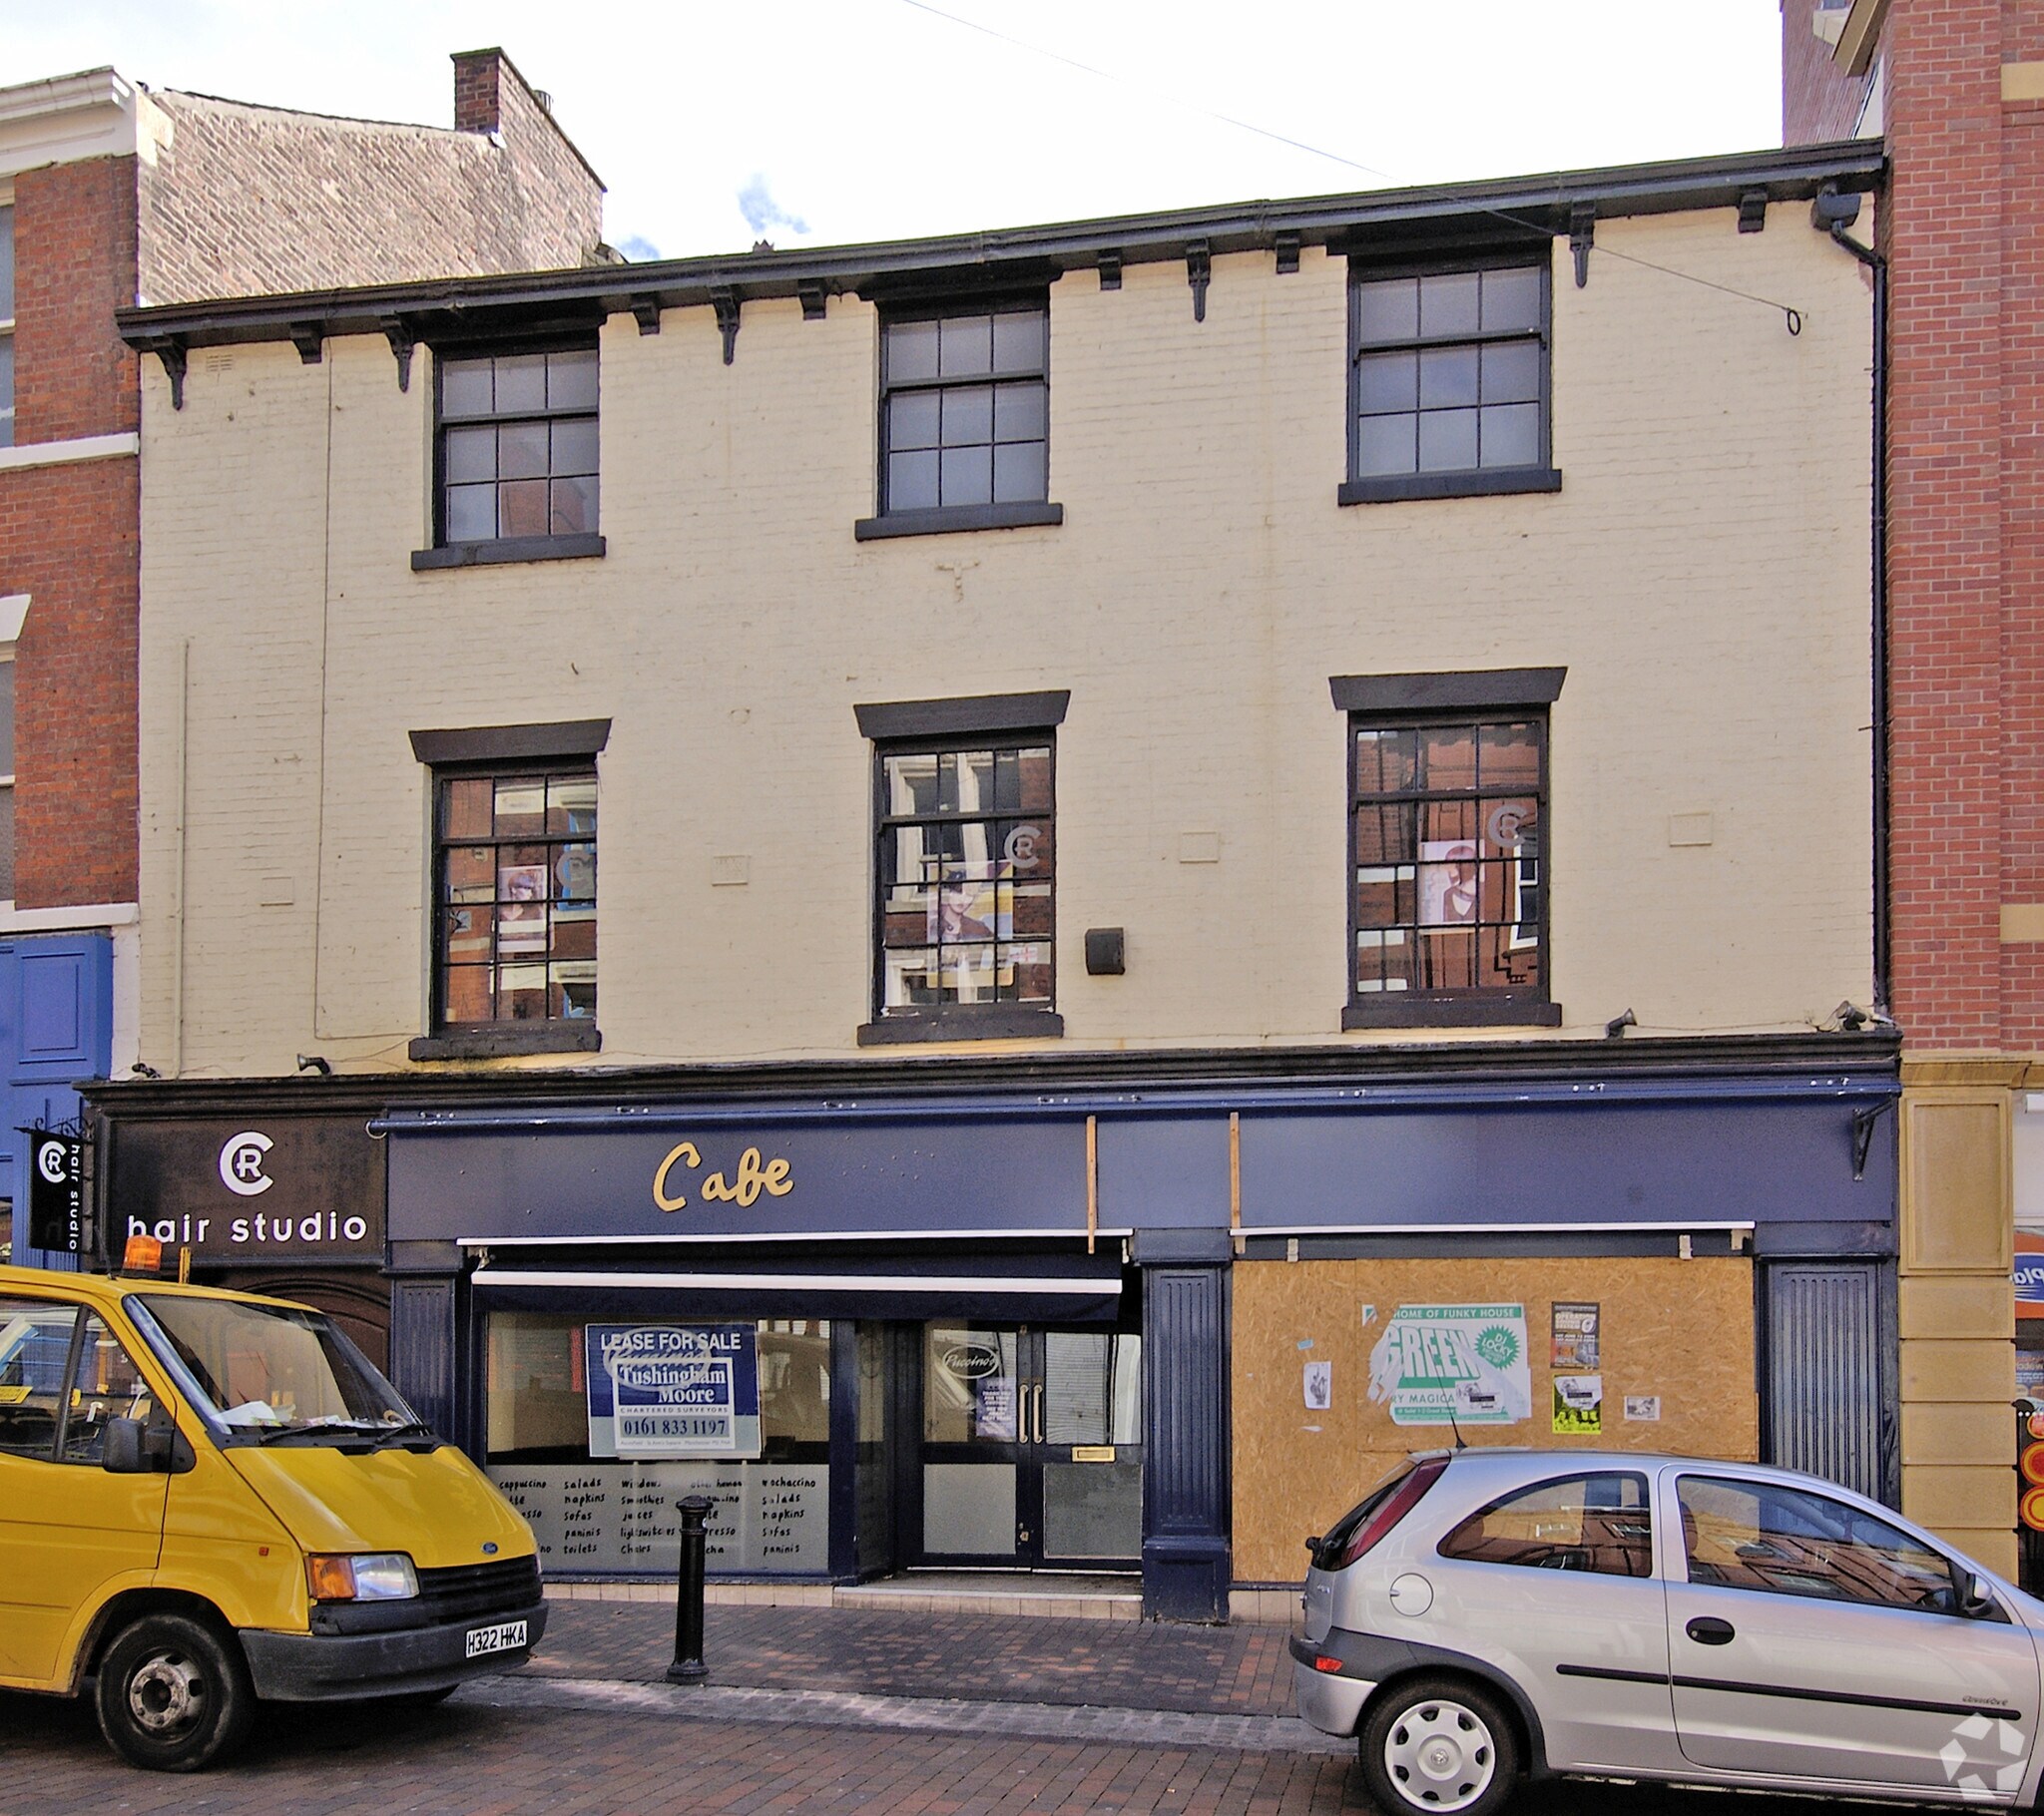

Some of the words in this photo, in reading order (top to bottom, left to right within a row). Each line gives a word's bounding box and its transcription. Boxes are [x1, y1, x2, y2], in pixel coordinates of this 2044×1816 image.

[70, 1143, 81, 1182] hair
[653, 1140, 794, 1212] Cafe
[69, 1190, 80, 1250] studio
[128, 1213, 210, 1244] hair
[230, 1211, 367, 1242] studio
[1393, 1308, 1422, 1319] HOME
[1426, 1308, 1440, 1318] OF
[1443, 1308, 1477, 1318] FUNKY
[1480, 1307, 1514, 1318] HOUSE
[601, 1333, 655, 1350] LEASE
[660, 1333, 693, 1350] FOR
[698, 1333, 743, 1350] SALE
[620, 1365, 726, 1387] Tushingham
[658, 1388, 715, 1404] Moore
[624, 1418, 656, 1436] 0161
[662, 1419, 688, 1435] 833
[694, 1419, 726, 1435] 1197
[499, 1479, 547, 1492] cappuccino
[564, 1478, 602, 1490] salads
[564, 1493, 605, 1507] napkins
[564, 1510, 592, 1522] sofas
[622, 1511, 653, 1522] juces
[564, 1528, 601, 1540] paninis
[564, 1544, 598, 1554] toilets
[764, 1544, 799, 1556] paninis
[467, 1628, 498, 1654] H322
[500, 1623, 525, 1647] HKA
